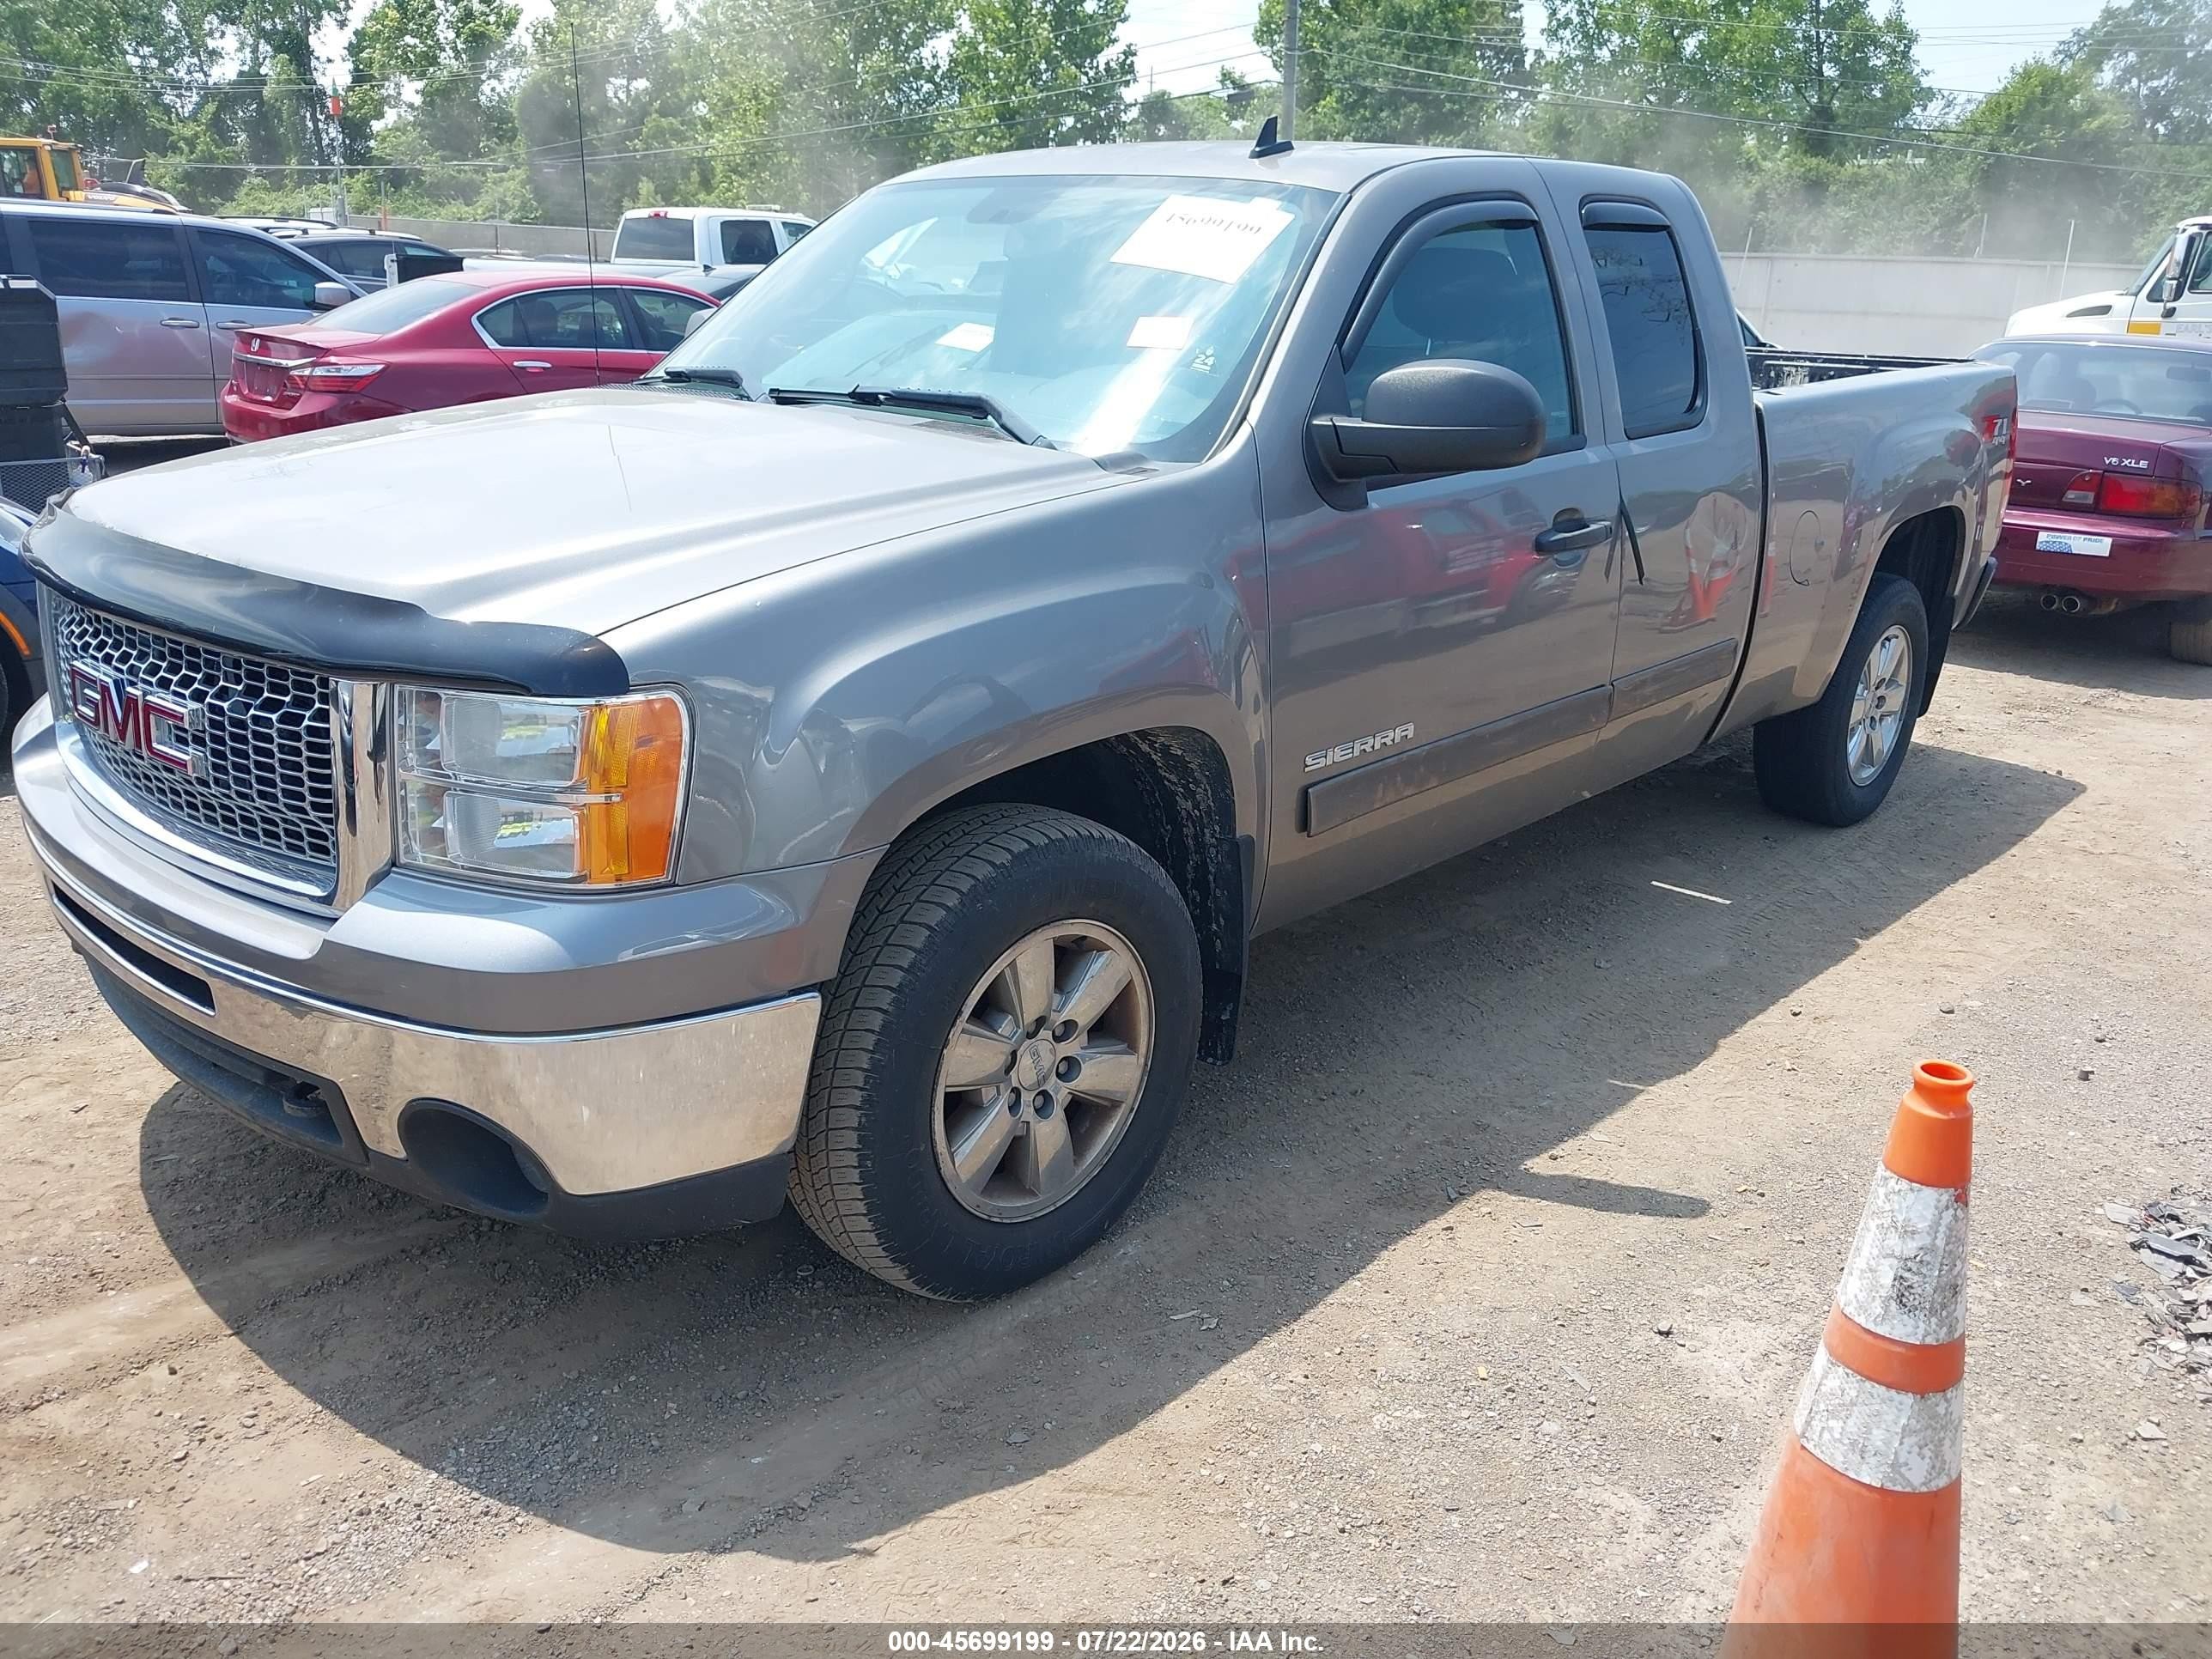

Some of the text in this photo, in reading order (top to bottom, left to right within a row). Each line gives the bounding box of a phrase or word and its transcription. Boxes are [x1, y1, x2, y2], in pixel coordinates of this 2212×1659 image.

[2103, 456, 2149, 469] V6 XLE
[70, 659, 195, 777] GMC
[1304, 721, 1415, 774] SIERRA
[1029, 1044, 1047, 1088] GMC
